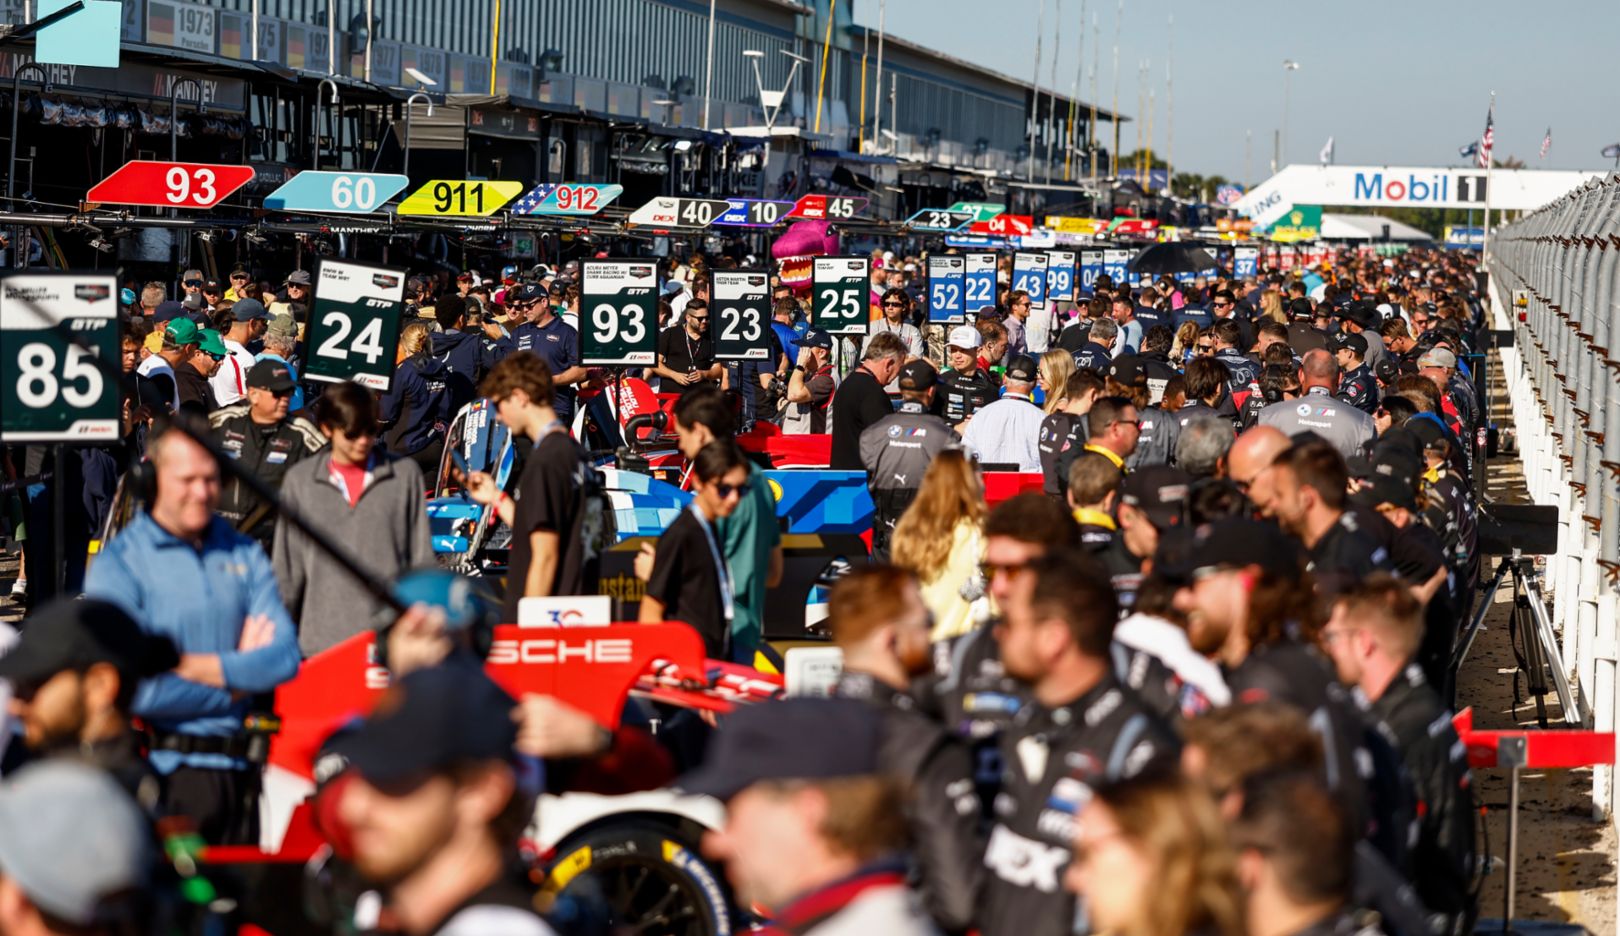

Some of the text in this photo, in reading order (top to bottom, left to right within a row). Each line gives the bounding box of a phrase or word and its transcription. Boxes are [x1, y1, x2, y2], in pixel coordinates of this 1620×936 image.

[178, 7, 213, 36] 1973
[245, 21, 275, 48] 175
[166, 166, 217, 204] 93
[331, 175, 376, 210] 60
[1354, 172, 1448, 202] Mobil
[433, 182, 483, 213] 911
[556, 186, 599, 211] 912
[828, 198, 853, 219] 45
[652, 214, 676, 223] DEX
[682, 200, 712, 225] 40
[723, 213, 746, 222] DEX
[751, 202, 778, 224] 10
[928, 212, 951, 228] 23
[988, 218, 1006, 232] 04
[1104, 265, 1125, 284] 73
[1236, 260, 1254, 275] 37
[966, 278, 992, 301] 22
[1014, 275, 1041, 298] 43
[1048, 270, 1070, 291] 99
[366, 299, 393, 308] GTP
[820, 289, 860, 318] 25
[932, 284, 959, 310] 52
[71, 319, 107, 331] GTP
[592, 303, 646, 343] 93
[721, 307, 761, 341] 23
[316, 311, 383, 364] 24
[16, 342, 104, 408] 85
[1298, 418, 1332, 429] Motorsport
[889, 439, 922, 449] Motorsport
[487, 639, 632, 664] SCHE
